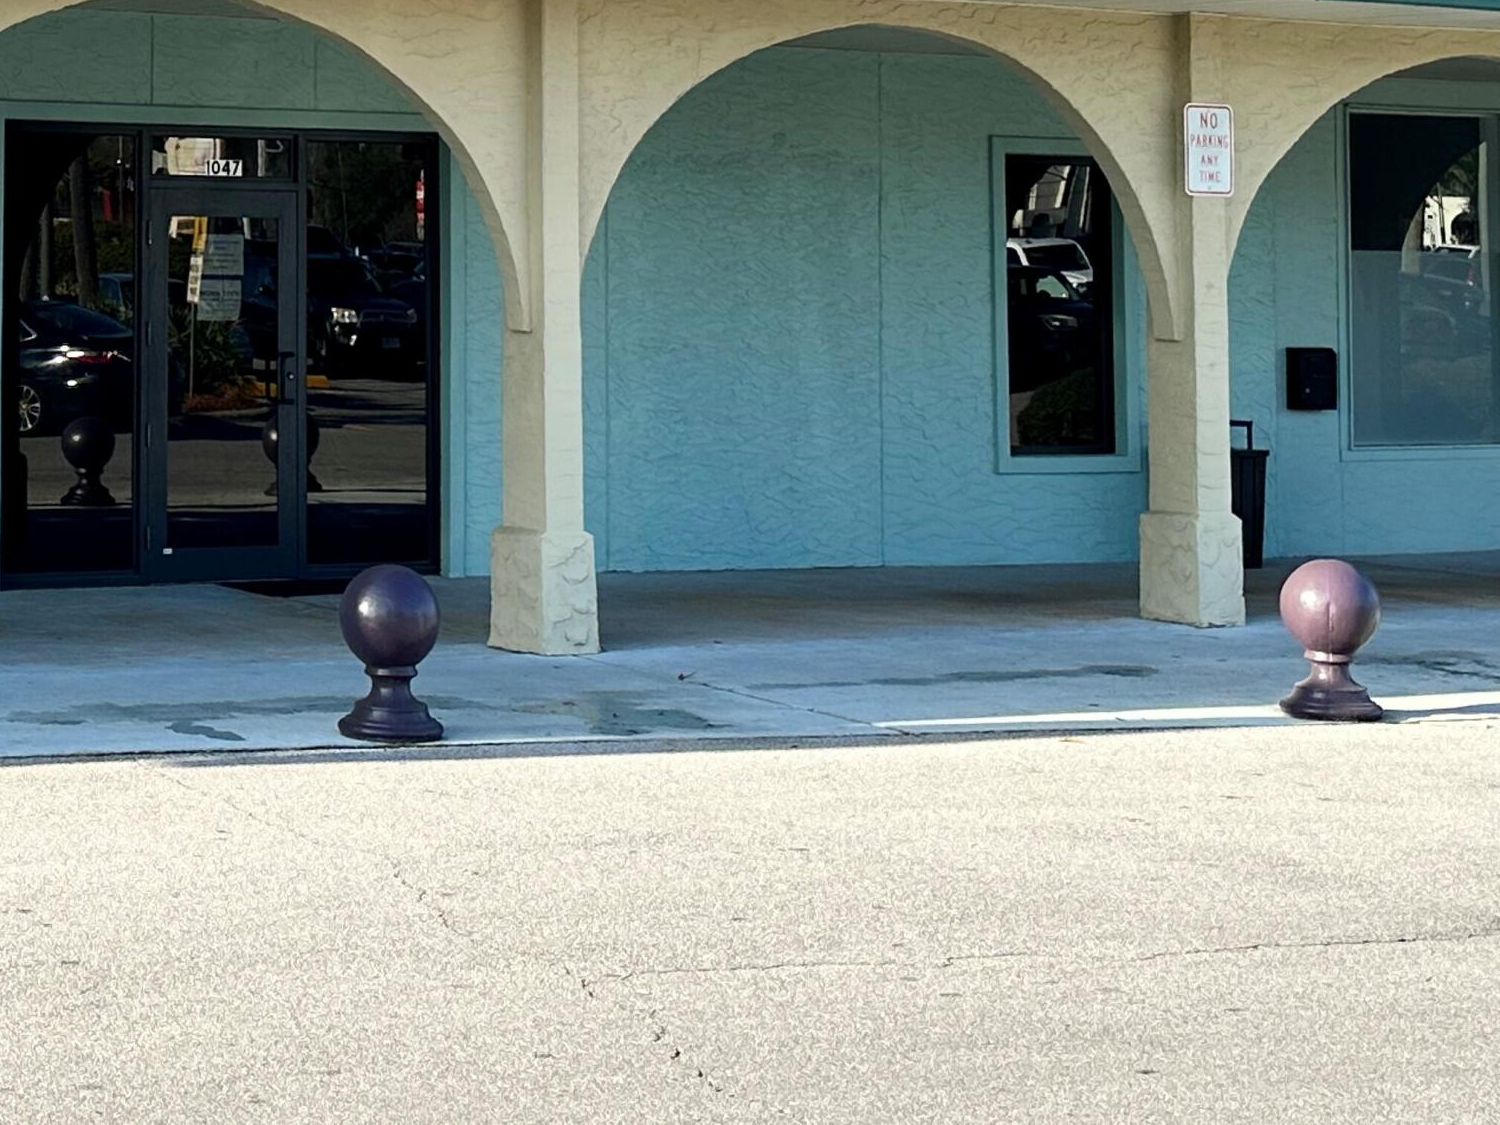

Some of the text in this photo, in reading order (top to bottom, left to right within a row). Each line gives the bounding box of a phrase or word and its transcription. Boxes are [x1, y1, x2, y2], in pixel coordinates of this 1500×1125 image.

[1200, 113, 1218, 129] NO
[1190, 134, 1228, 148] PARKING
[205, 160, 240, 175] 1047
[1201, 155, 1218, 166] ANY
[1200, 171, 1220, 182] TIME
